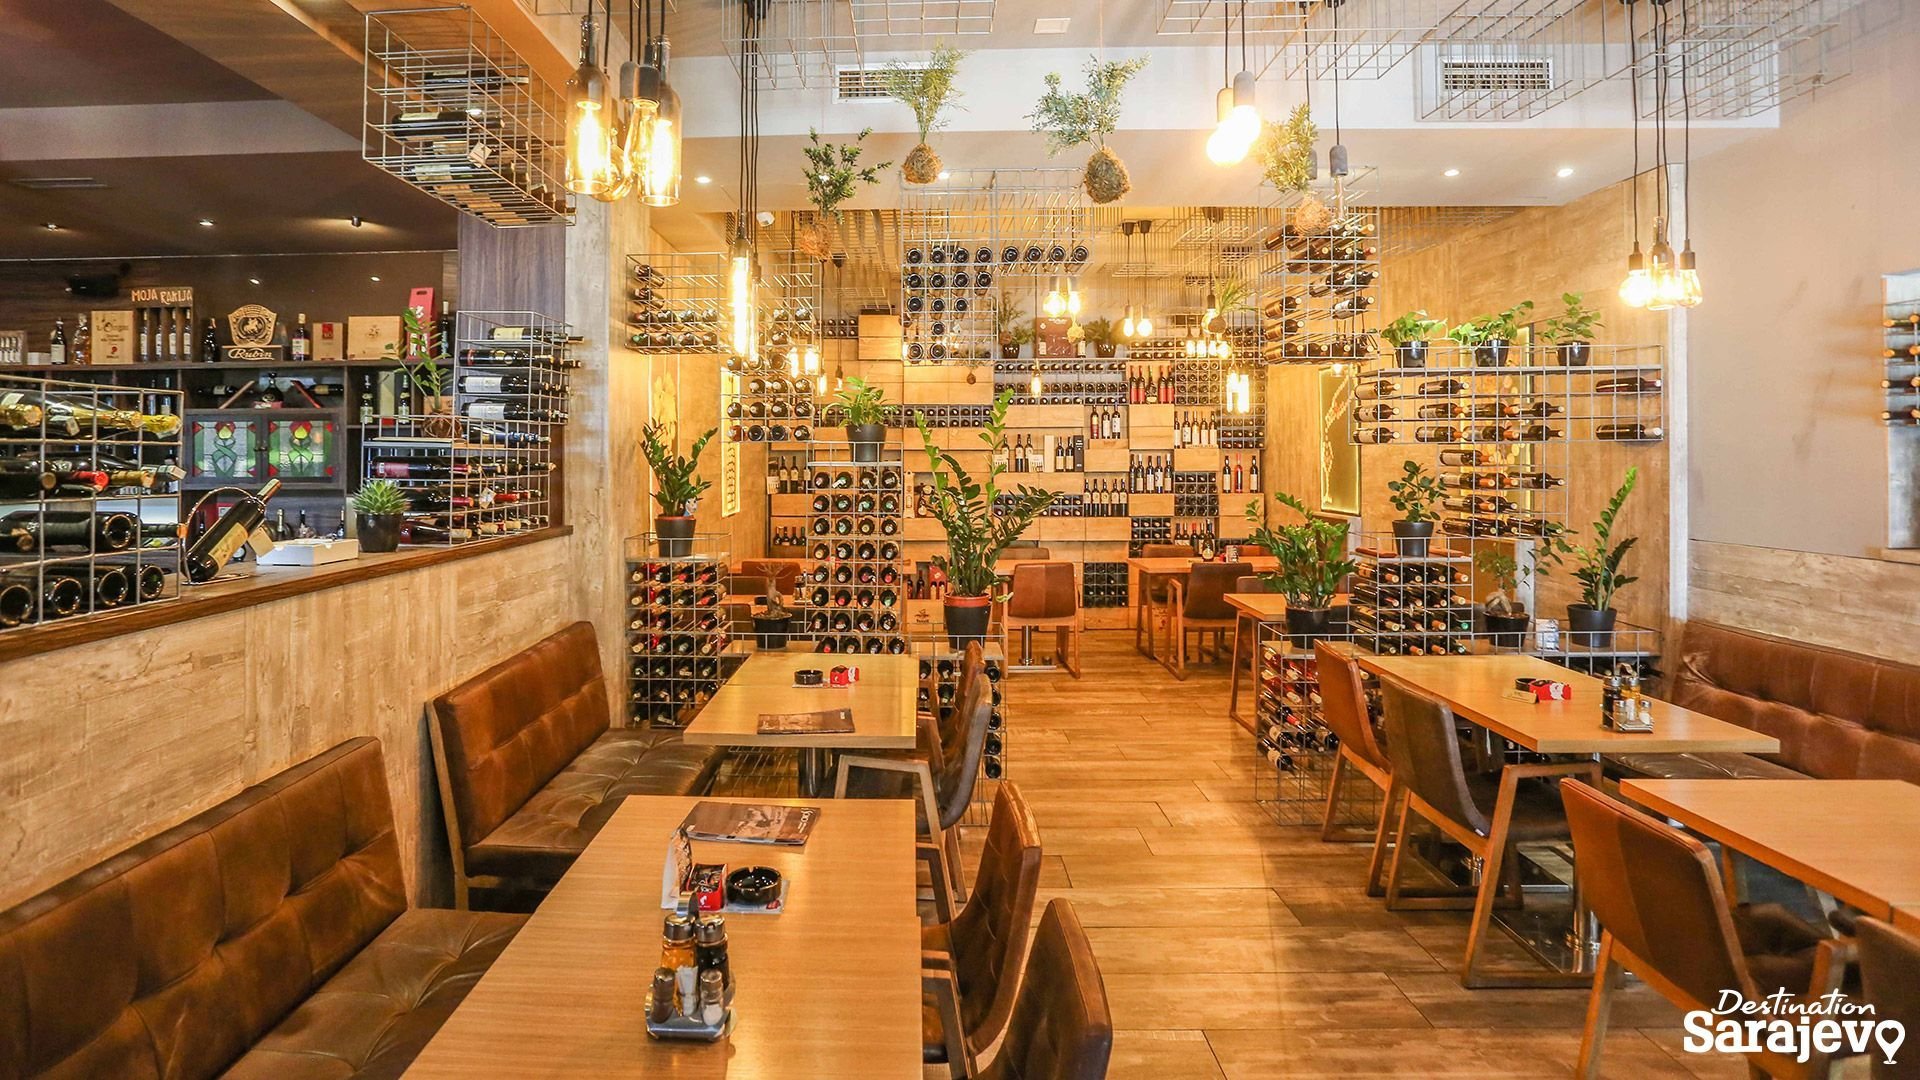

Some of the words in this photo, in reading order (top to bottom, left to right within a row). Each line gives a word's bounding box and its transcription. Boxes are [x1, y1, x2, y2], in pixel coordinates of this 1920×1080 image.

[131, 288, 158, 302] MOJA
[160, 289, 193, 305] RAKIJA
[228, 347, 275, 361] Rubin
